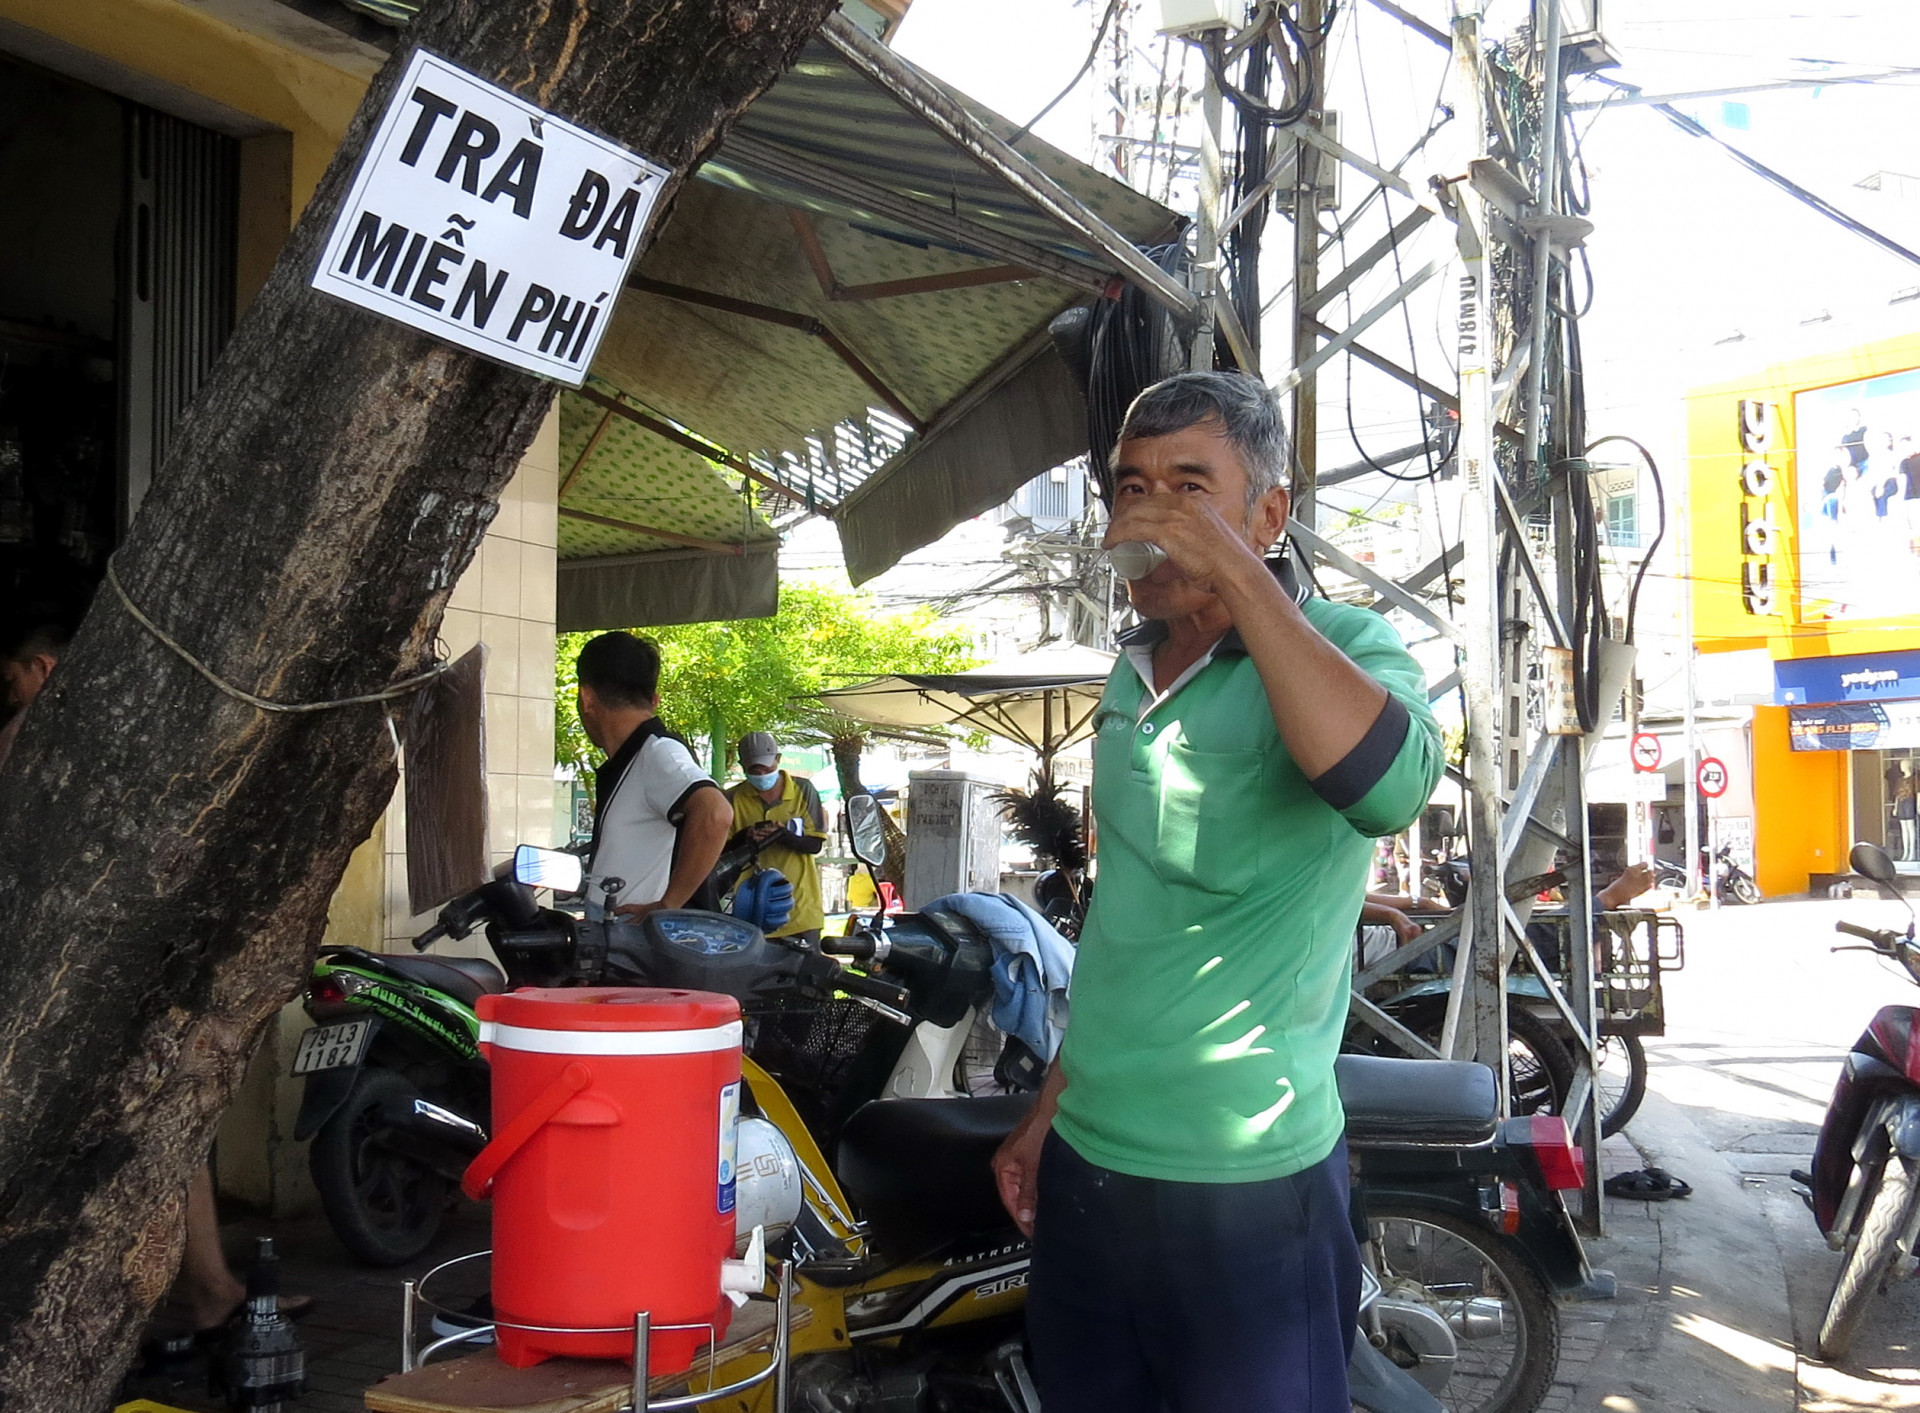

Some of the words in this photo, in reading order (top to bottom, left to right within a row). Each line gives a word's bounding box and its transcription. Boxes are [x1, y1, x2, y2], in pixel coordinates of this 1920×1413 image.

[399, 86, 545, 220] TRÀ
[558, 168, 653, 260] ĐÁ
[338, 210, 509, 330] MIỄN
[506, 282, 609, 363] PHÍ
[308, 1023, 359, 1049] 79-L3
[302, 1044, 352, 1071] 1182
[943, 1240, 1033, 1267] 4-STROK
